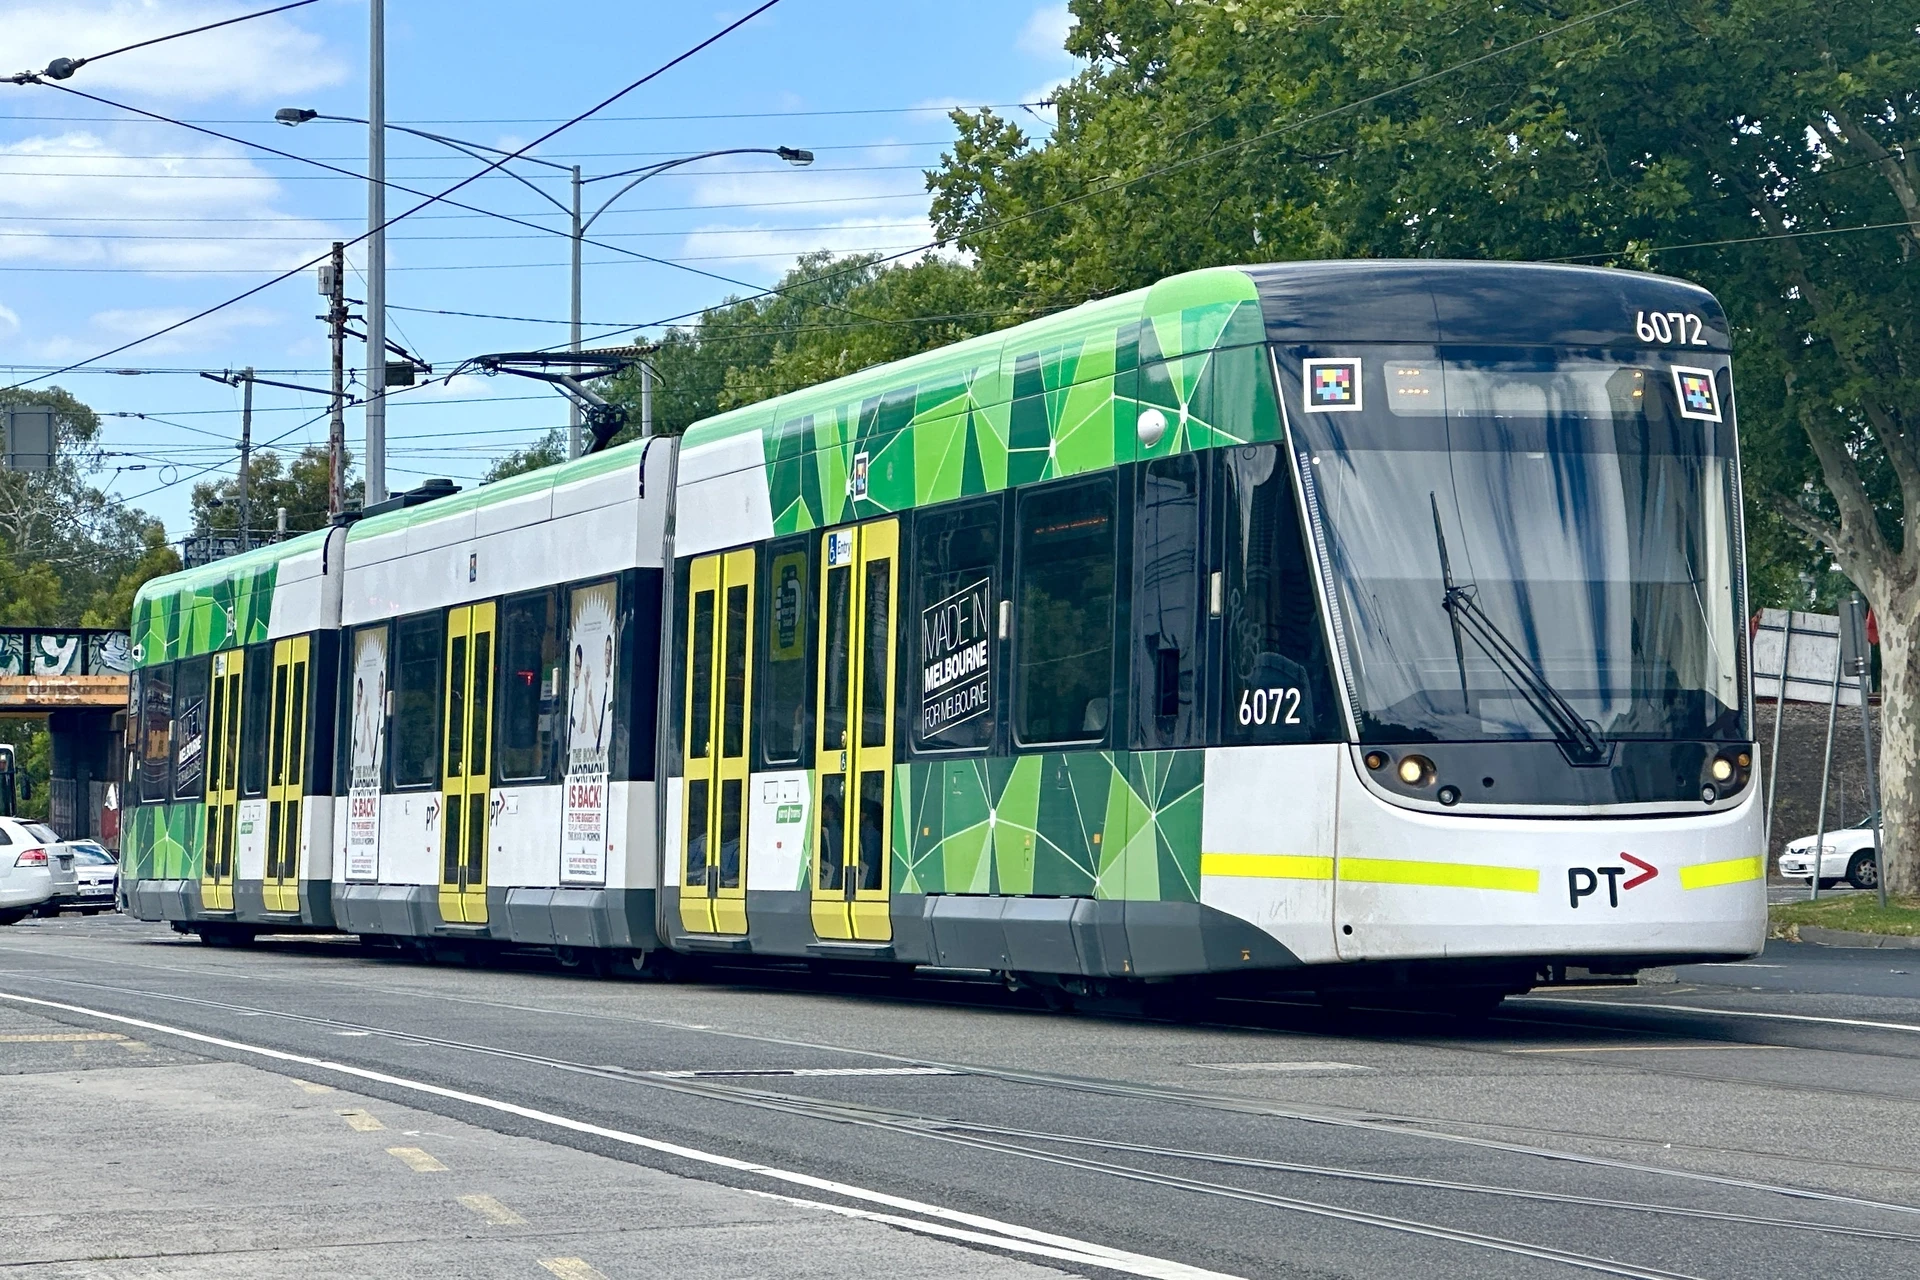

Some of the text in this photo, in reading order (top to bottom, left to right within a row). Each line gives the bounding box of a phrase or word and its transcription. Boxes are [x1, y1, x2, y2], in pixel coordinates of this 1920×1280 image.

[1636, 311, 1708, 346] 6072
[837, 540, 852, 557] Entry
[924, 587, 988, 663] MADE IN
[924, 639, 988, 693] MELBOURNE
[924, 680, 988, 730] FOR MELBOURNE
[1239, 687, 1301, 726] 6072
[568, 784, 603, 808] IS BACK!
